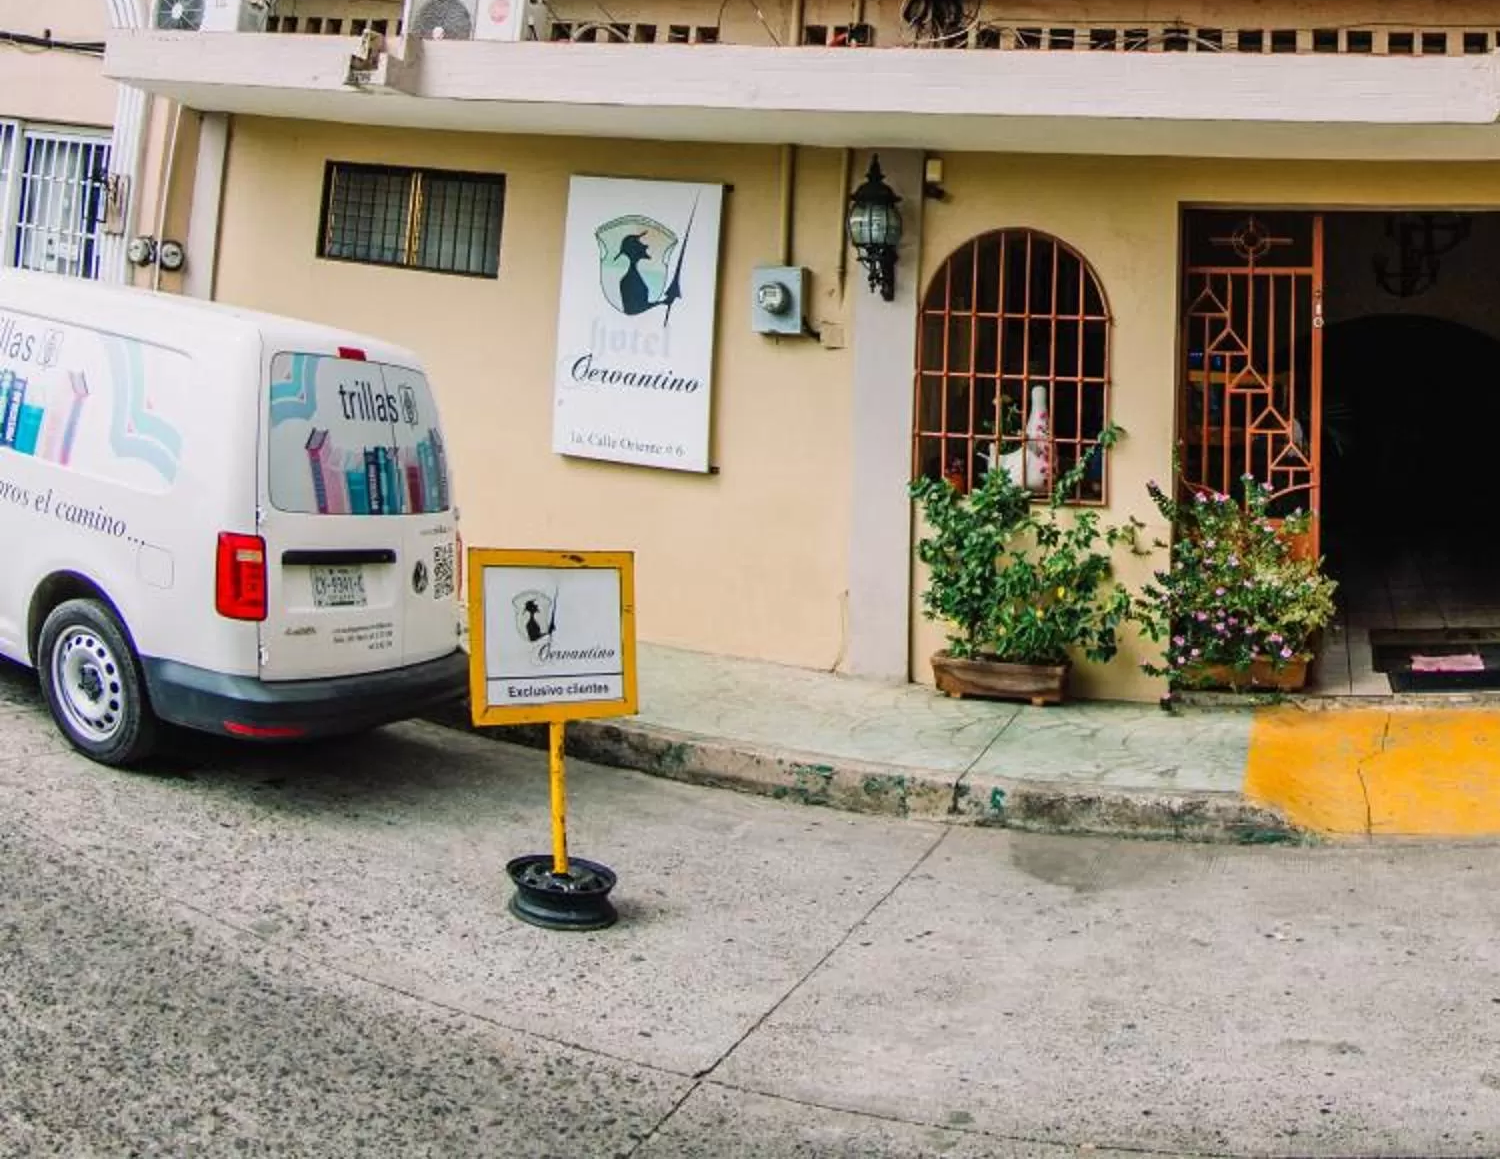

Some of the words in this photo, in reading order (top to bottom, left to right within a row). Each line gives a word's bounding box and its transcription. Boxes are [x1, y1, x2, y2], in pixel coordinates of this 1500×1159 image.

[571, 353, 699, 392] Cervantino
[339, 380, 399, 424] trillas
[587, 431, 617, 449] Calle
[34, 488, 53, 514] el
[538, 642, 615, 661] Cervantino
[508, 685, 564, 698] Exclusivo
[566, 682, 609, 696] clientes
